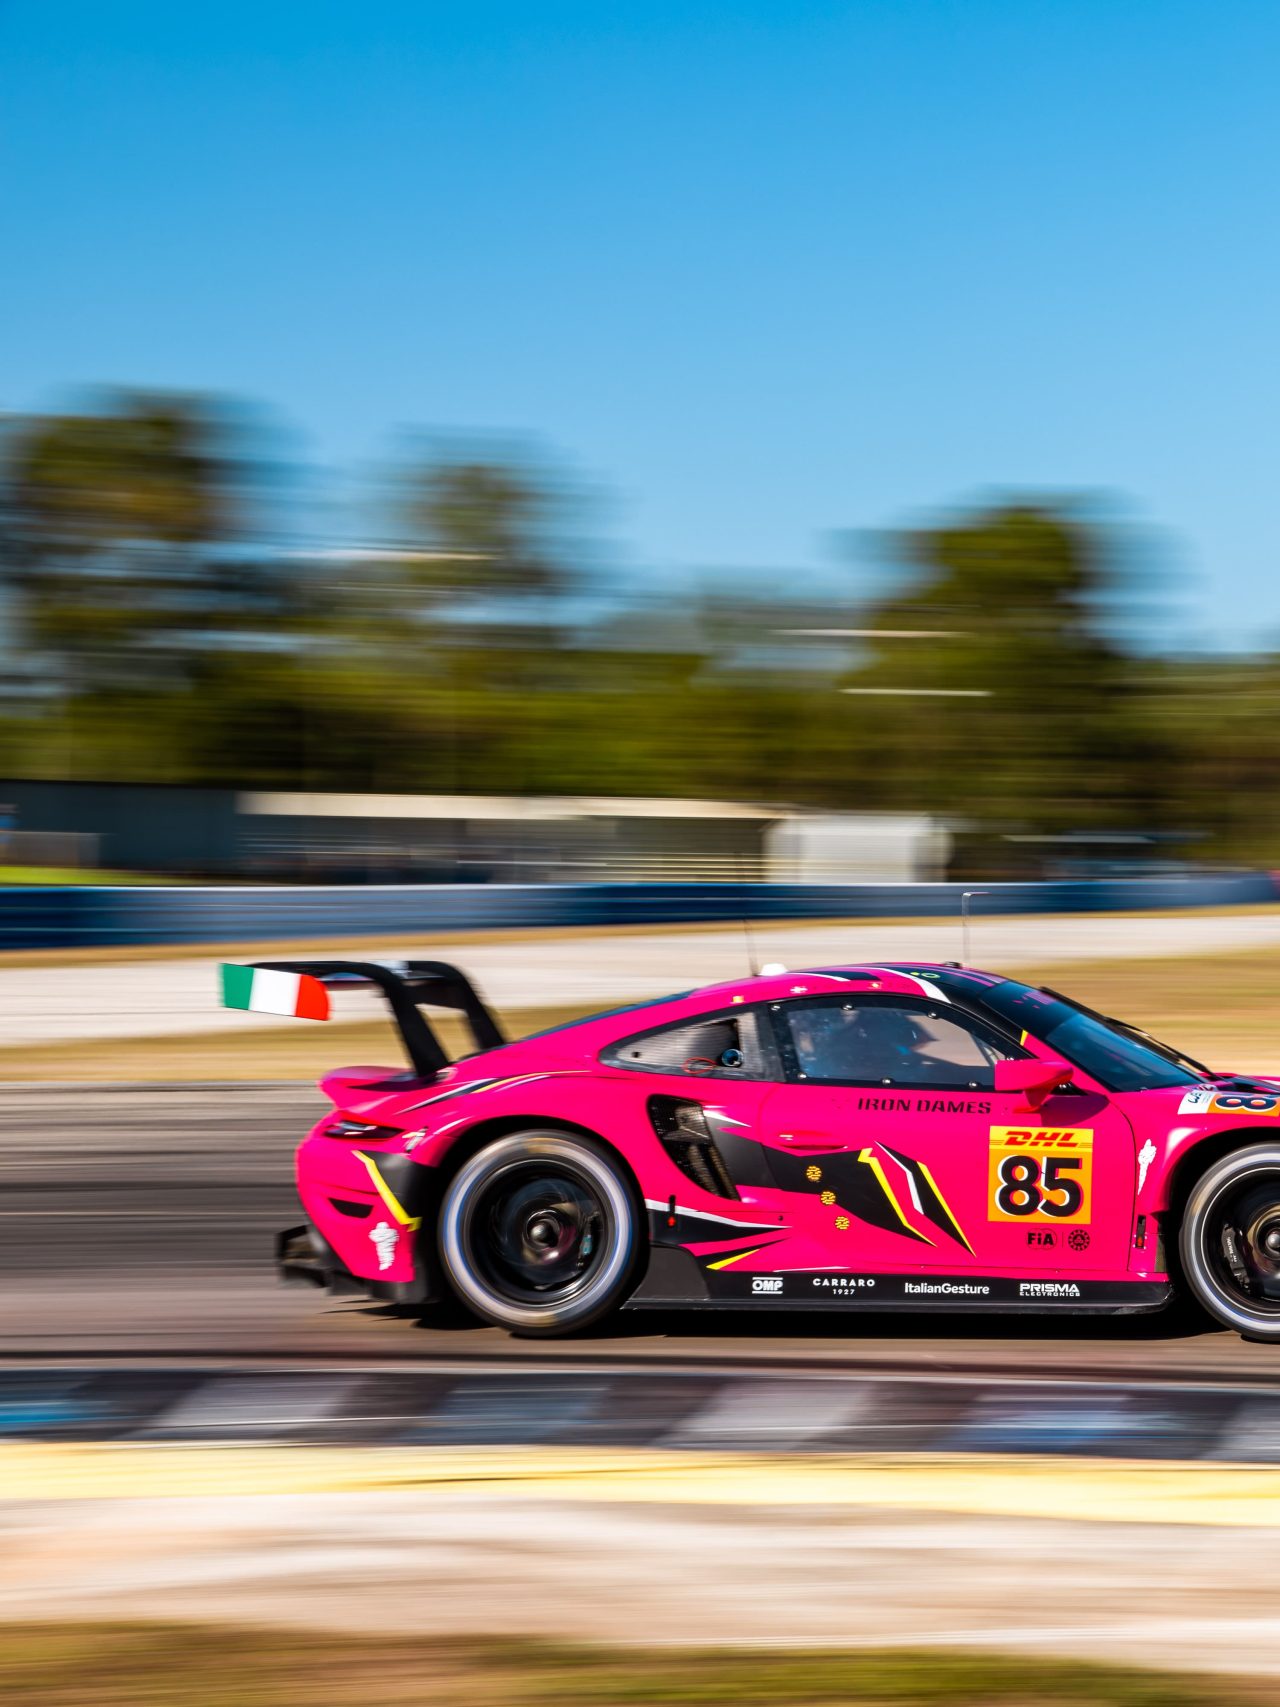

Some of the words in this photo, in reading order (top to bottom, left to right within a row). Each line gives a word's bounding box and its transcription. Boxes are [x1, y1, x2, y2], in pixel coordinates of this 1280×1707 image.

[858, 1098, 911, 1111] IRON
[917, 1100, 991, 1114] DAMES
[1004, 1131, 1078, 1147] DHL
[995, 1155, 1083, 1217] 85
[752, 1280, 783, 1291] OMP
[812, 1278, 875, 1287] CARRARO
[904, 1282, 990, 1295] ItalianGesture
[1019, 1283, 1080, 1292] PRISMA
